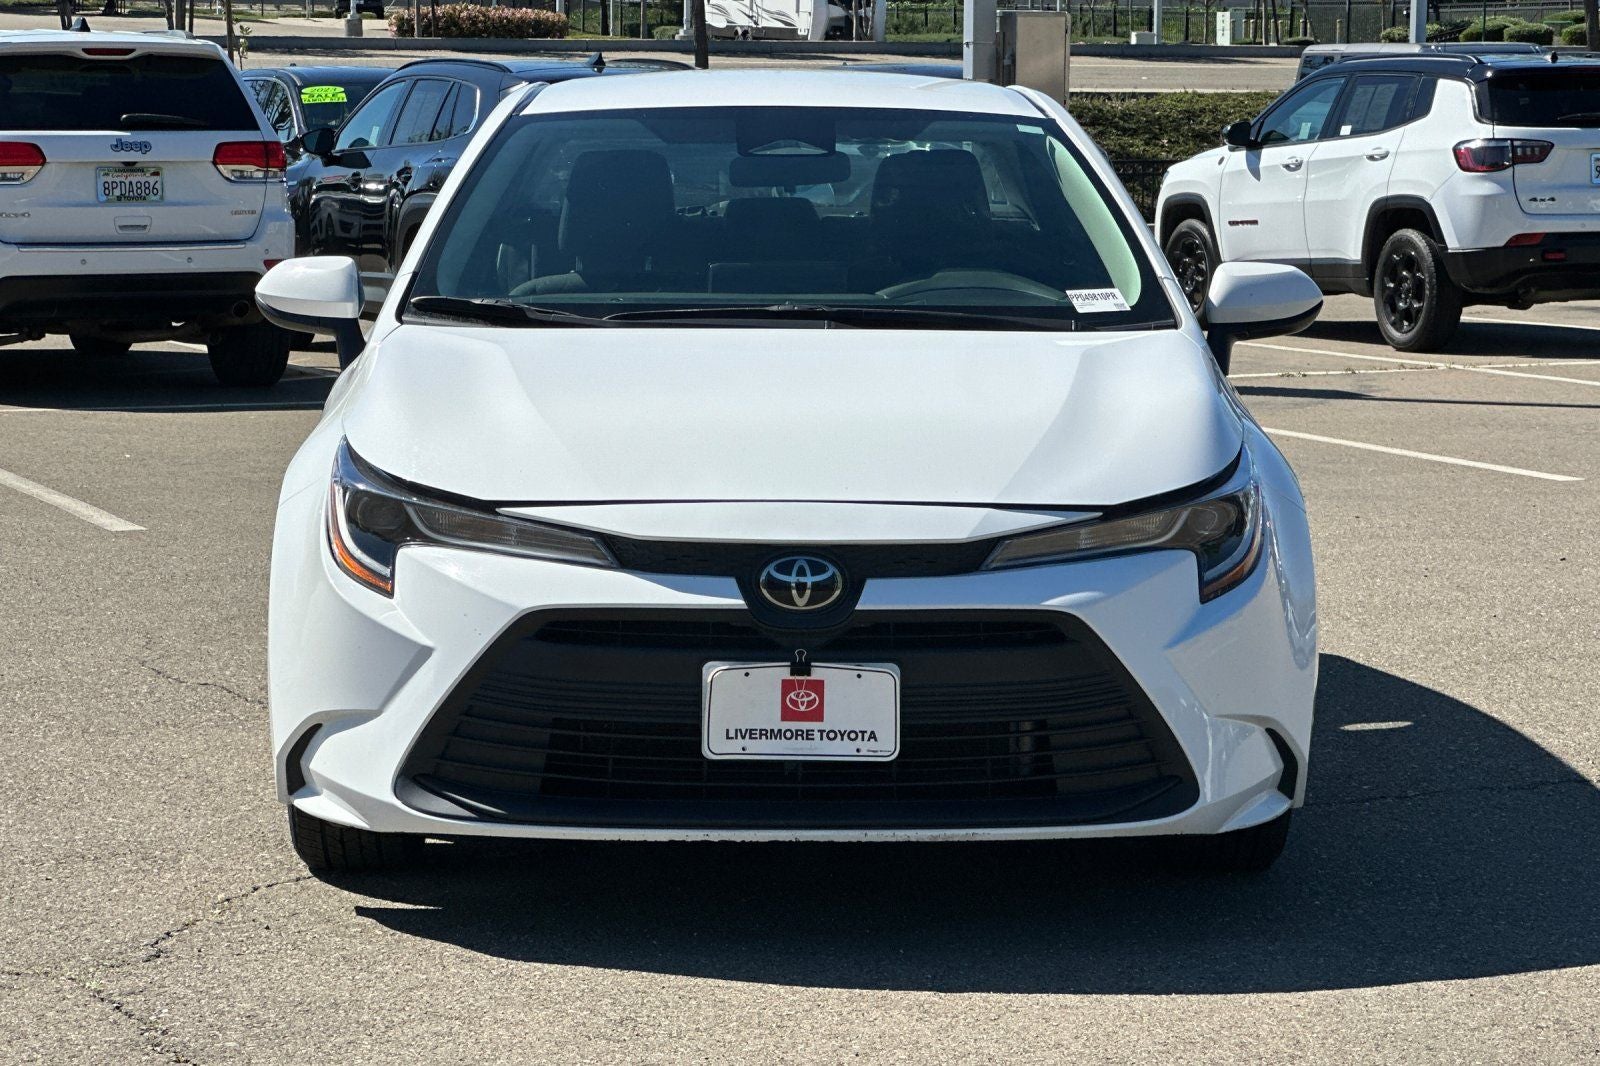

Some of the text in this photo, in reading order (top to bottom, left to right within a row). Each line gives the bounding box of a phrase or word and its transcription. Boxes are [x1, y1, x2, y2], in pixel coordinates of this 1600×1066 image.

[110, 138, 152, 154] Jeep
[103, 181, 159, 197] 8PDA886
[725, 728, 878, 742] LIVERMORE TOYOTA
